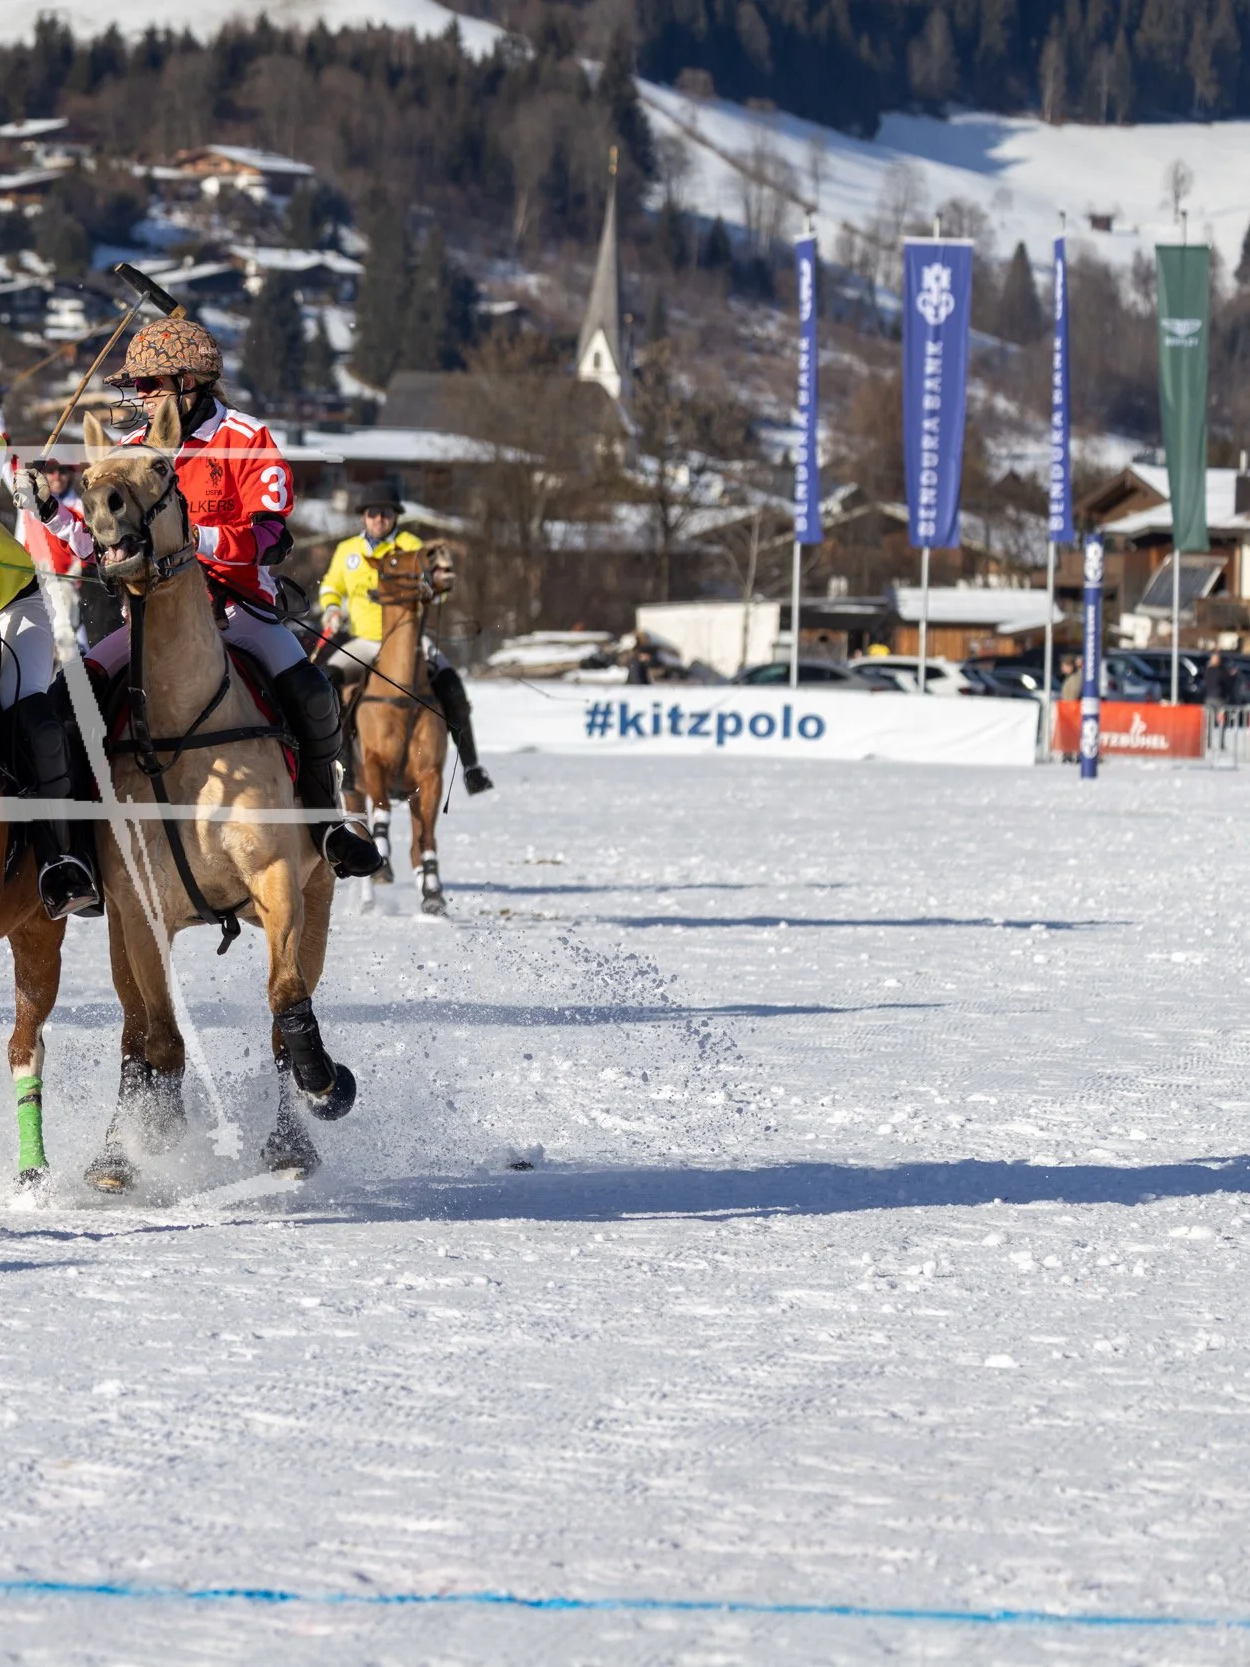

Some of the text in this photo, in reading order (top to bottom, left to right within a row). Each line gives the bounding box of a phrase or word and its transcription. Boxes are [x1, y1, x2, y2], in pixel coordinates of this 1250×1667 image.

[917, 340, 943, 537] BENDURA BANK
[1048, 336, 1065, 531] BENDURA BANK
[189, 498, 236, 513] LKERS
[260, 465, 288, 512] 3
[584, 700, 827, 747] #kitzpolo
